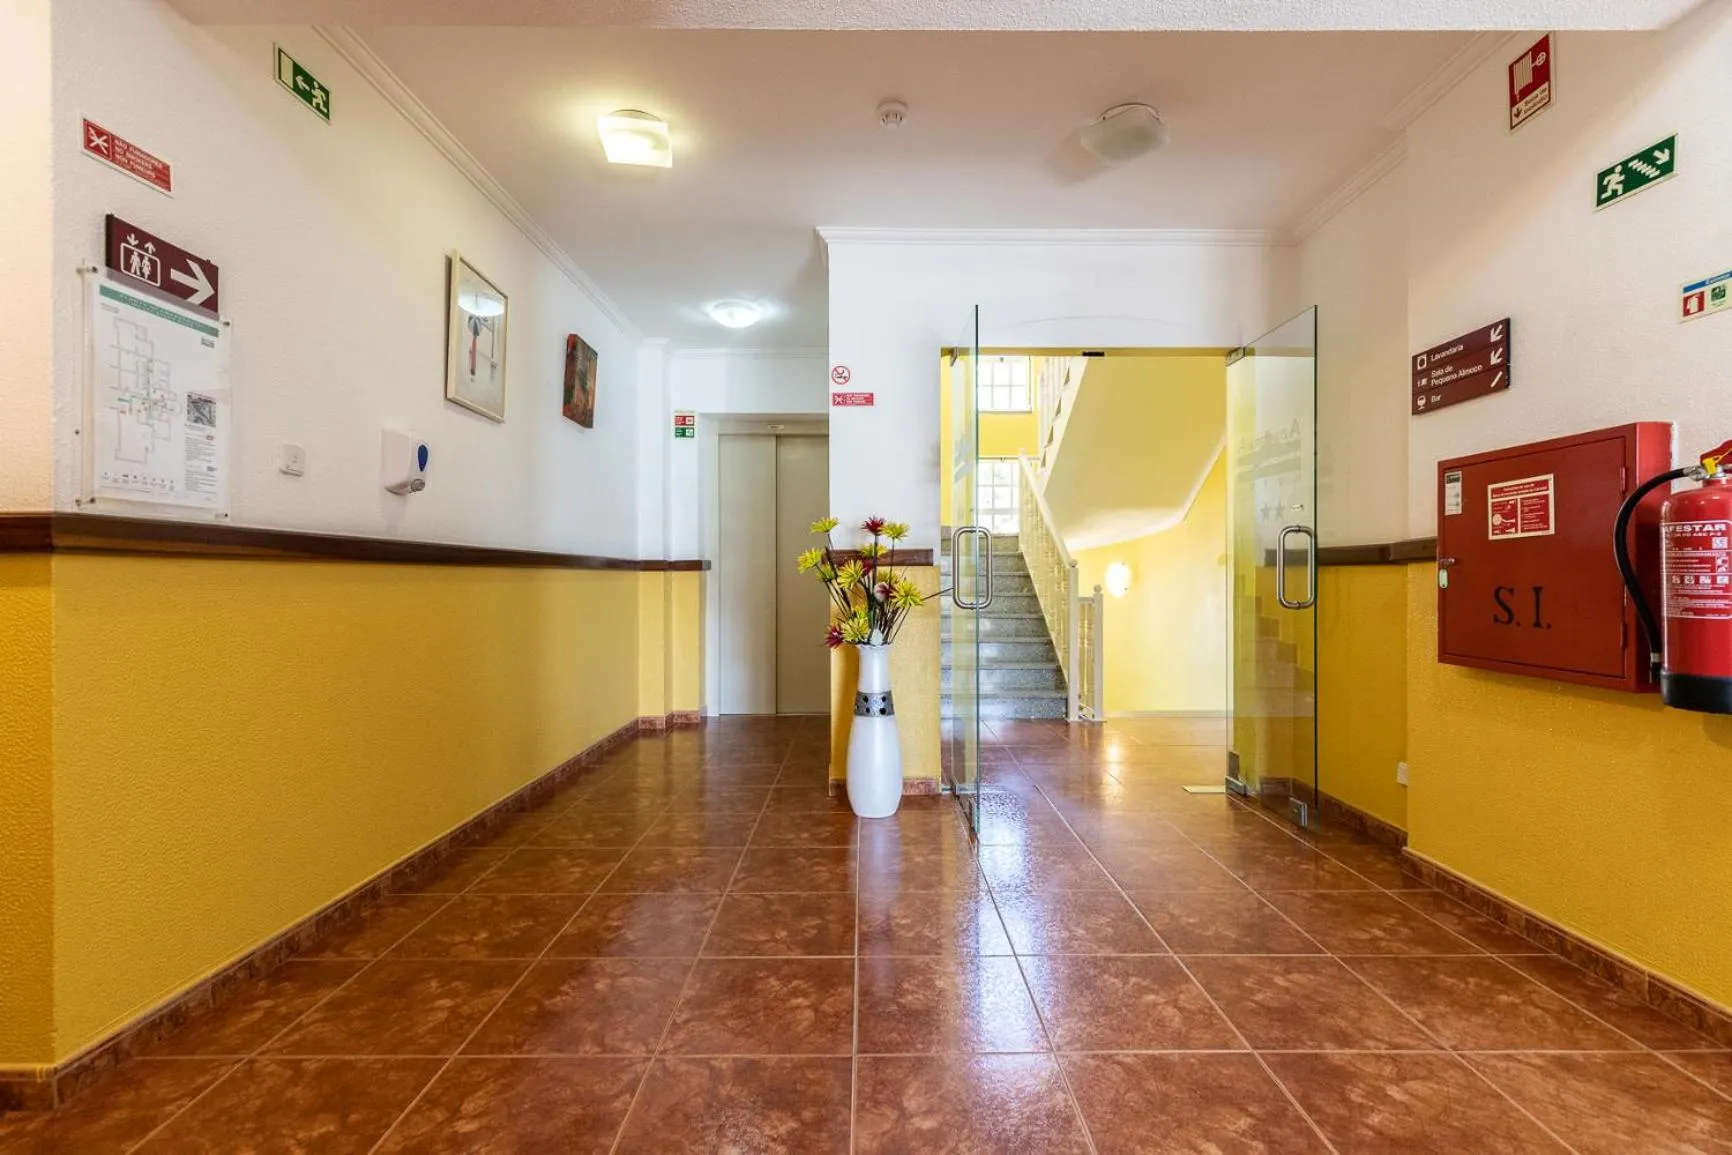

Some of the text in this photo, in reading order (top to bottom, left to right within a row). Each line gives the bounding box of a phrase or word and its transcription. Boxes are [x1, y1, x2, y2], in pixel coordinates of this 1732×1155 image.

[1431, 344, 1464, 361] Lavandaria
[1431, 365, 1453, 378] Sala de
[1431, 373, 1458, 386] Pequeno
[1431, 394, 1442, 403] Bar
